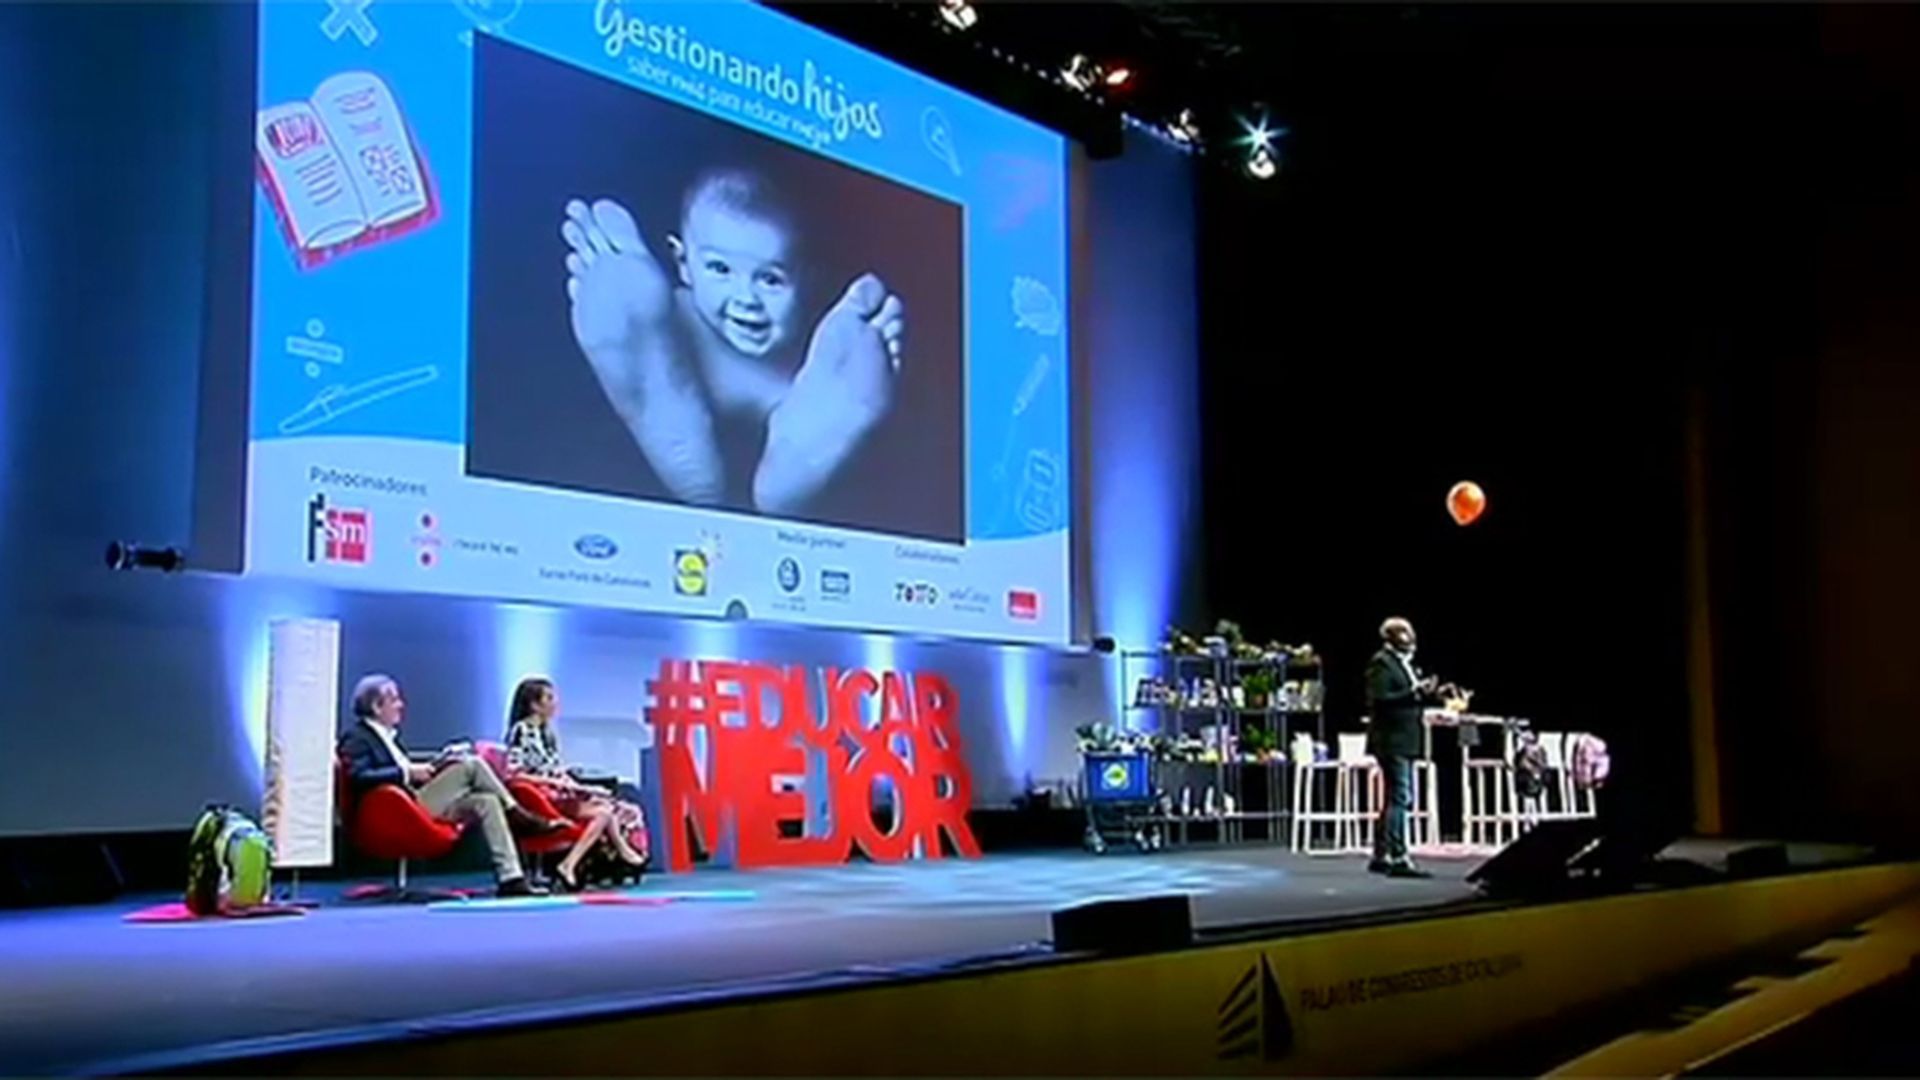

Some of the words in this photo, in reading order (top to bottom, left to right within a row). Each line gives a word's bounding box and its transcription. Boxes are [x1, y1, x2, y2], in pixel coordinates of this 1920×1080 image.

[743, 98, 789, 130] educar
[803, 59, 883, 140] hijos
[309, 465, 429, 496] Patrocinadores
[645, 660, 959, 750] #EDUCAR
[660, 730, 983, 873] MEJOR
